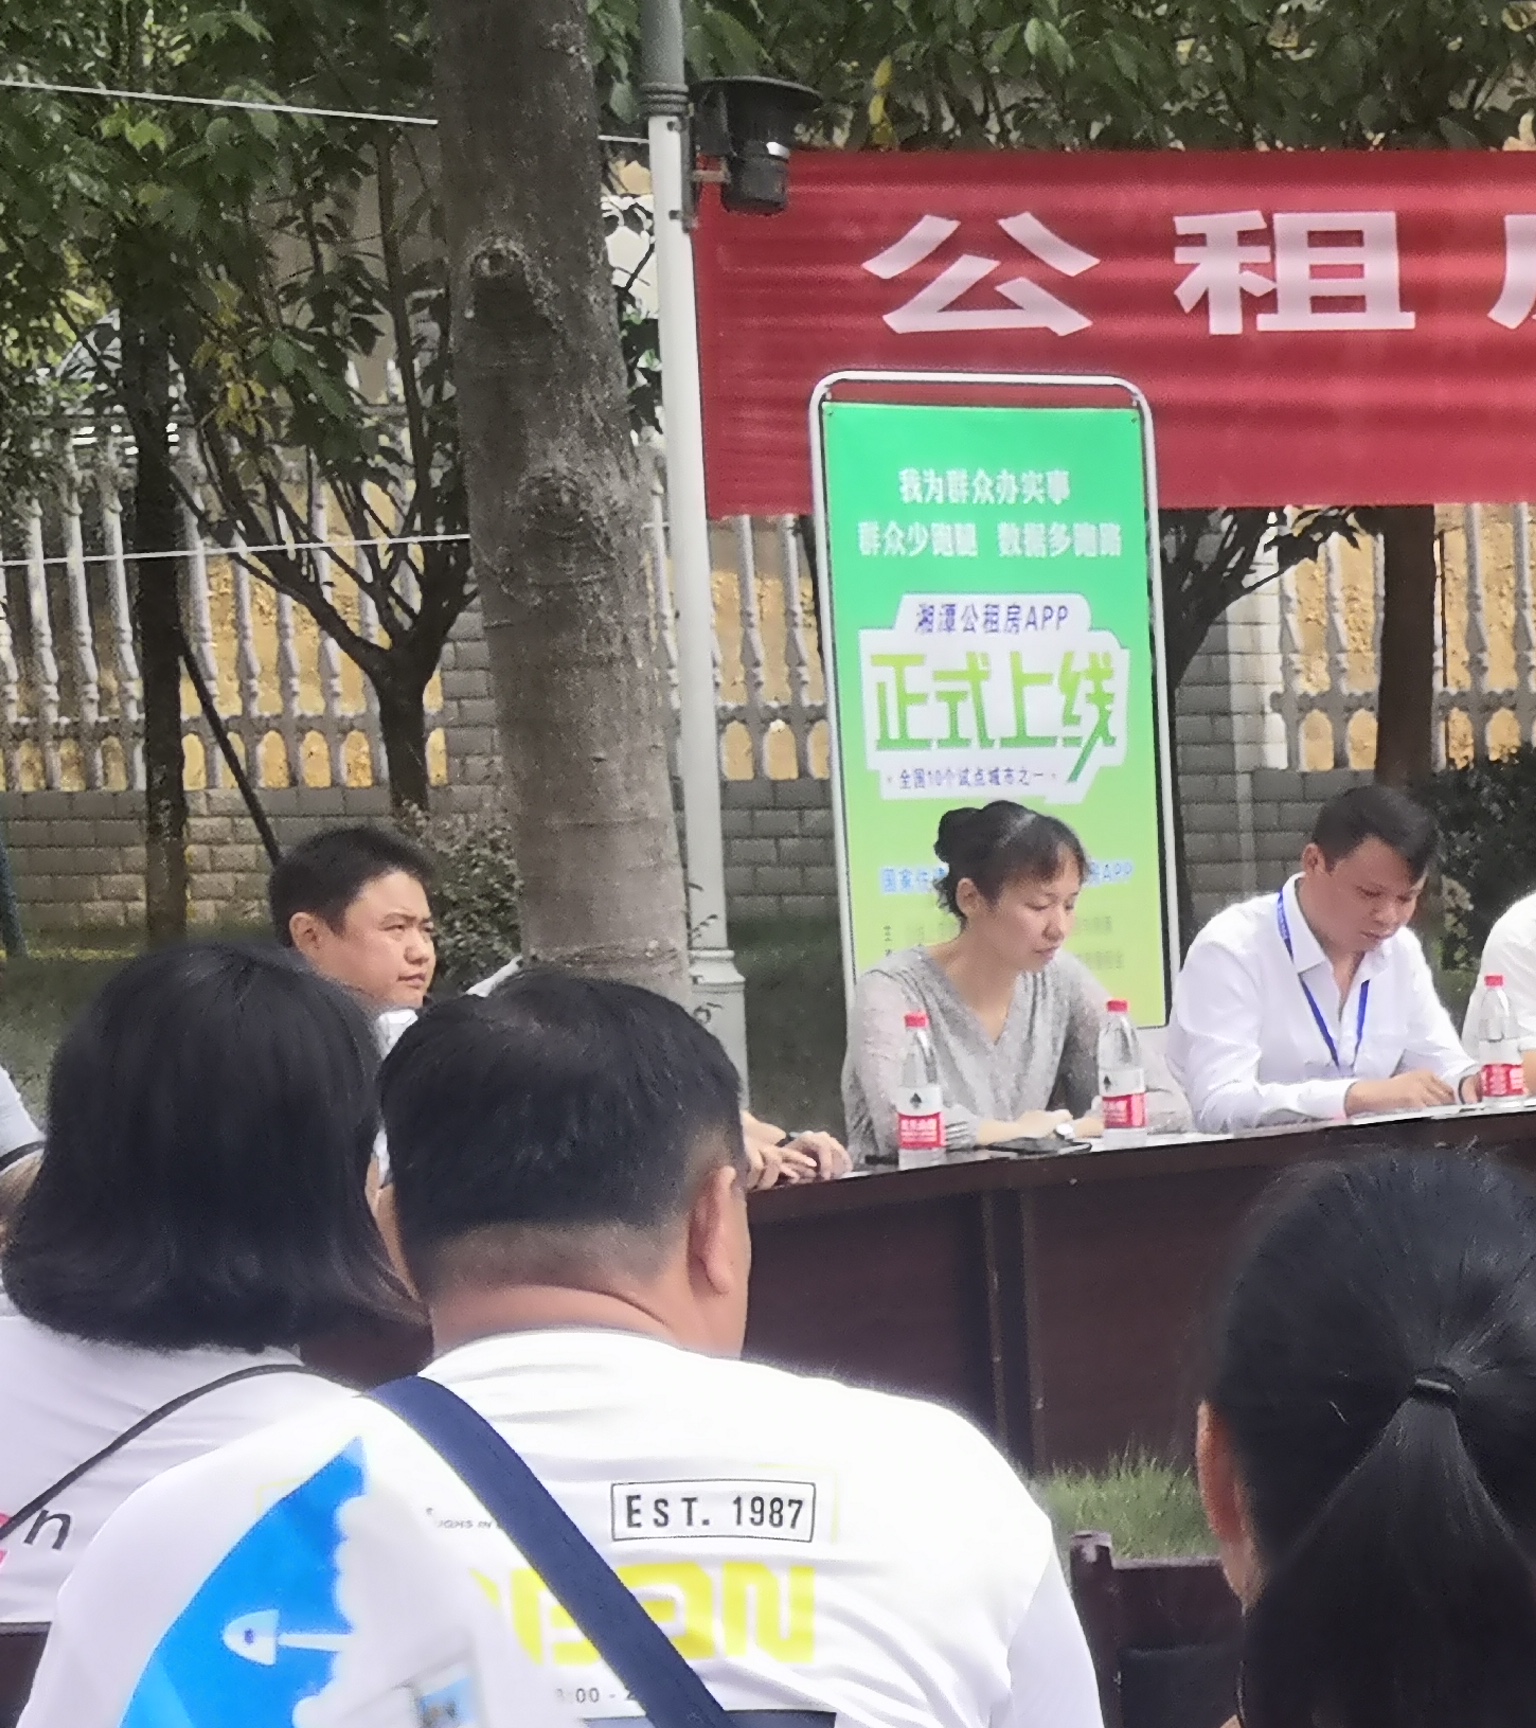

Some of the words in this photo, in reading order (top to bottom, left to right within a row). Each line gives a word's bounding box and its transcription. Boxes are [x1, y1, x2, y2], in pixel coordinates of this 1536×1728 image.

[899, 467, 1071, 505] 我为群众办实事
[915, 602, 1070, 635] 湘潭公租房APP
[870, 650, 1117, 784] 正式上线
[625, 1494, 711, 1529] EST.
[732, 1495, 804, 1530] 1987
